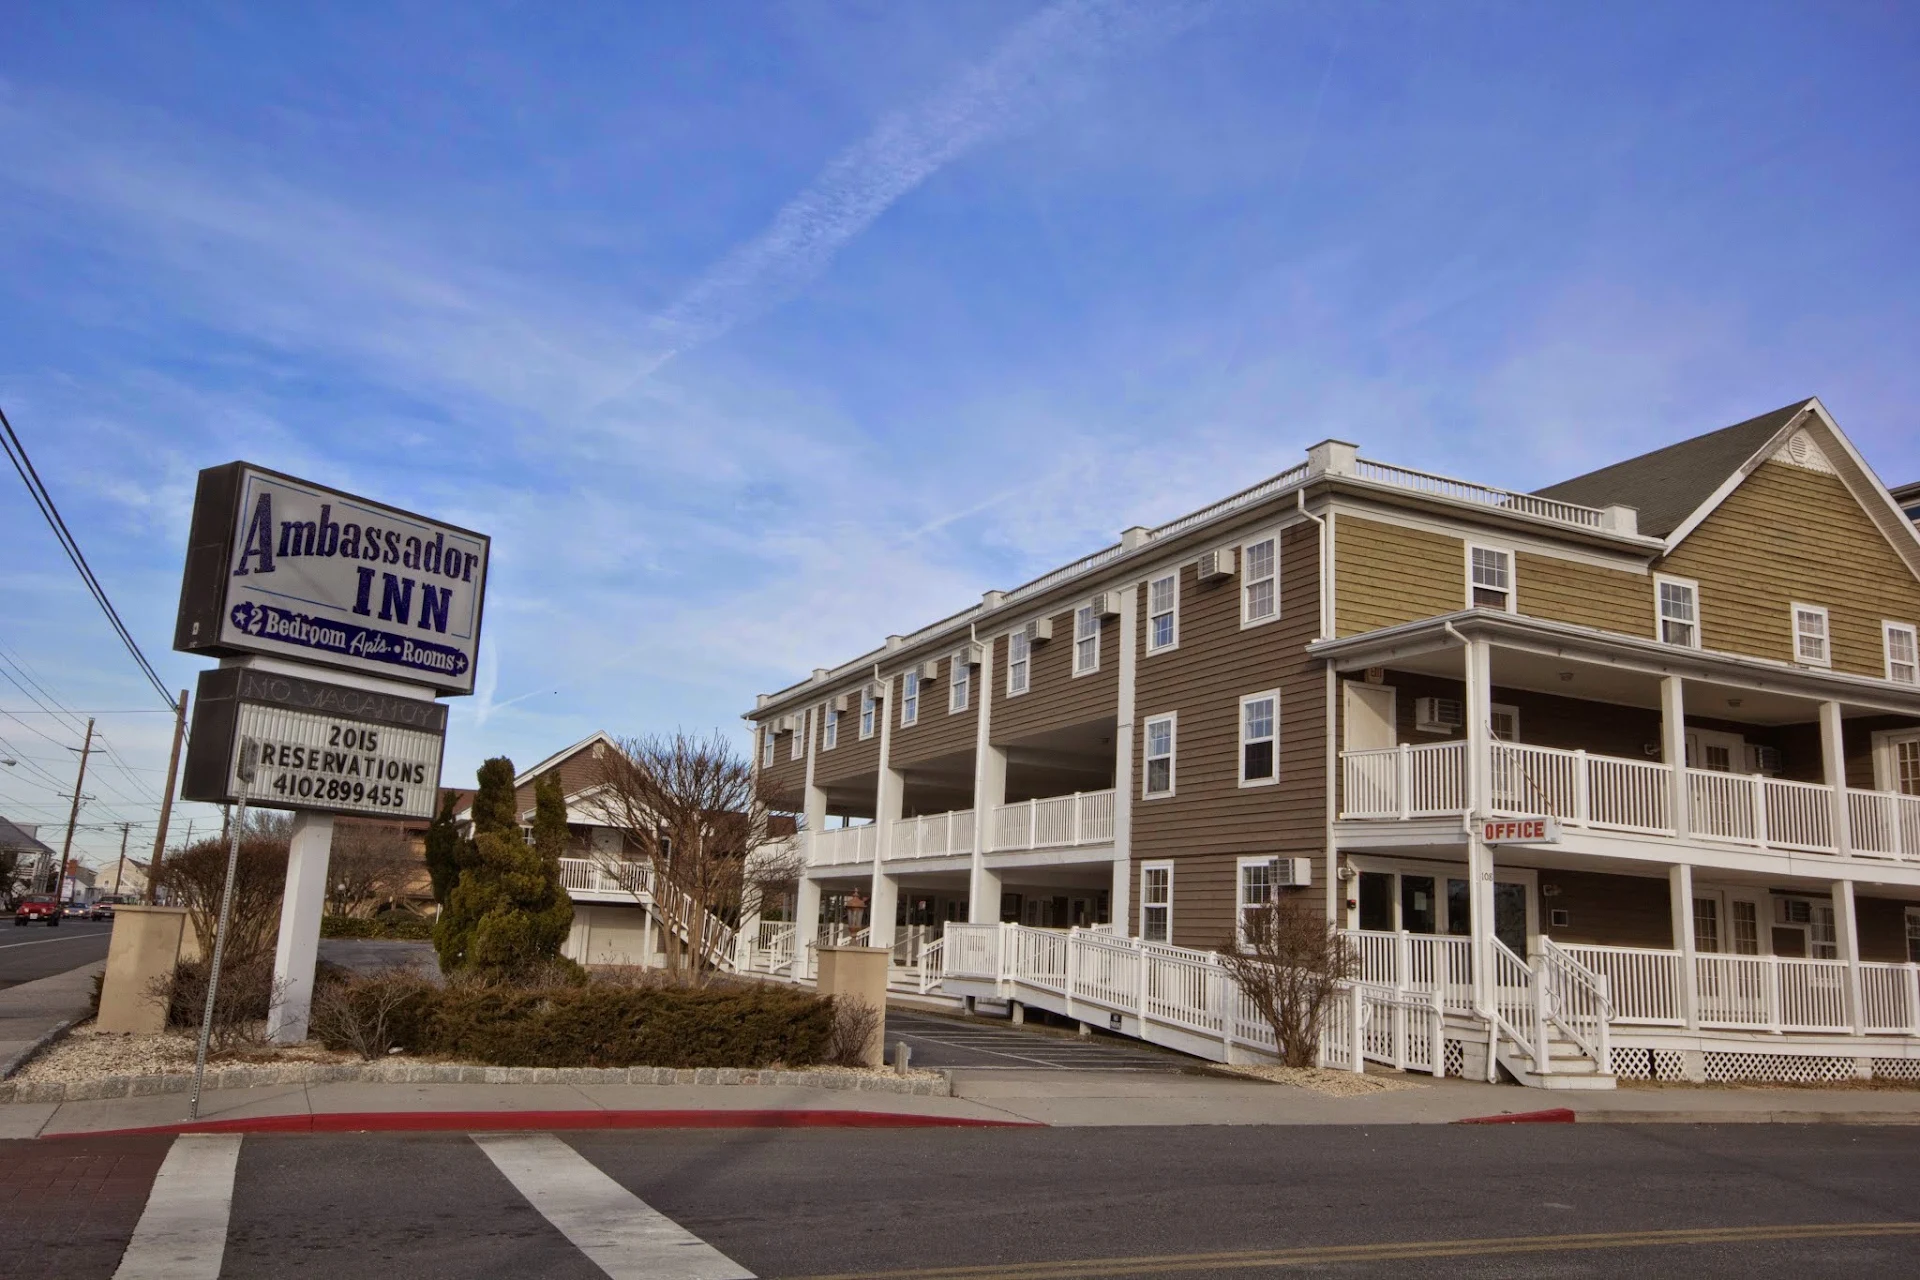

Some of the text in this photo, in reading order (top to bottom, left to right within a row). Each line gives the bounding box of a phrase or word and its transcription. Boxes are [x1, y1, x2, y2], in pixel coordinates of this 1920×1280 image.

[233, 493, 478, 583] Ambassador
[352, 566, 453, 634] INN
[248, 607, 265, 635] 2
[264, 609, 346, 649] Bedroom
[244, 676, 291, 701] NO
[329, 726, 378, 751] 2015
[261, 743, 425, 784] RESERVATIONS
[273, 773, 404, 807] 4102899455
[1485, 821, 1544, 840] OFFICE
[1481, 872, 1493, 881] 108
